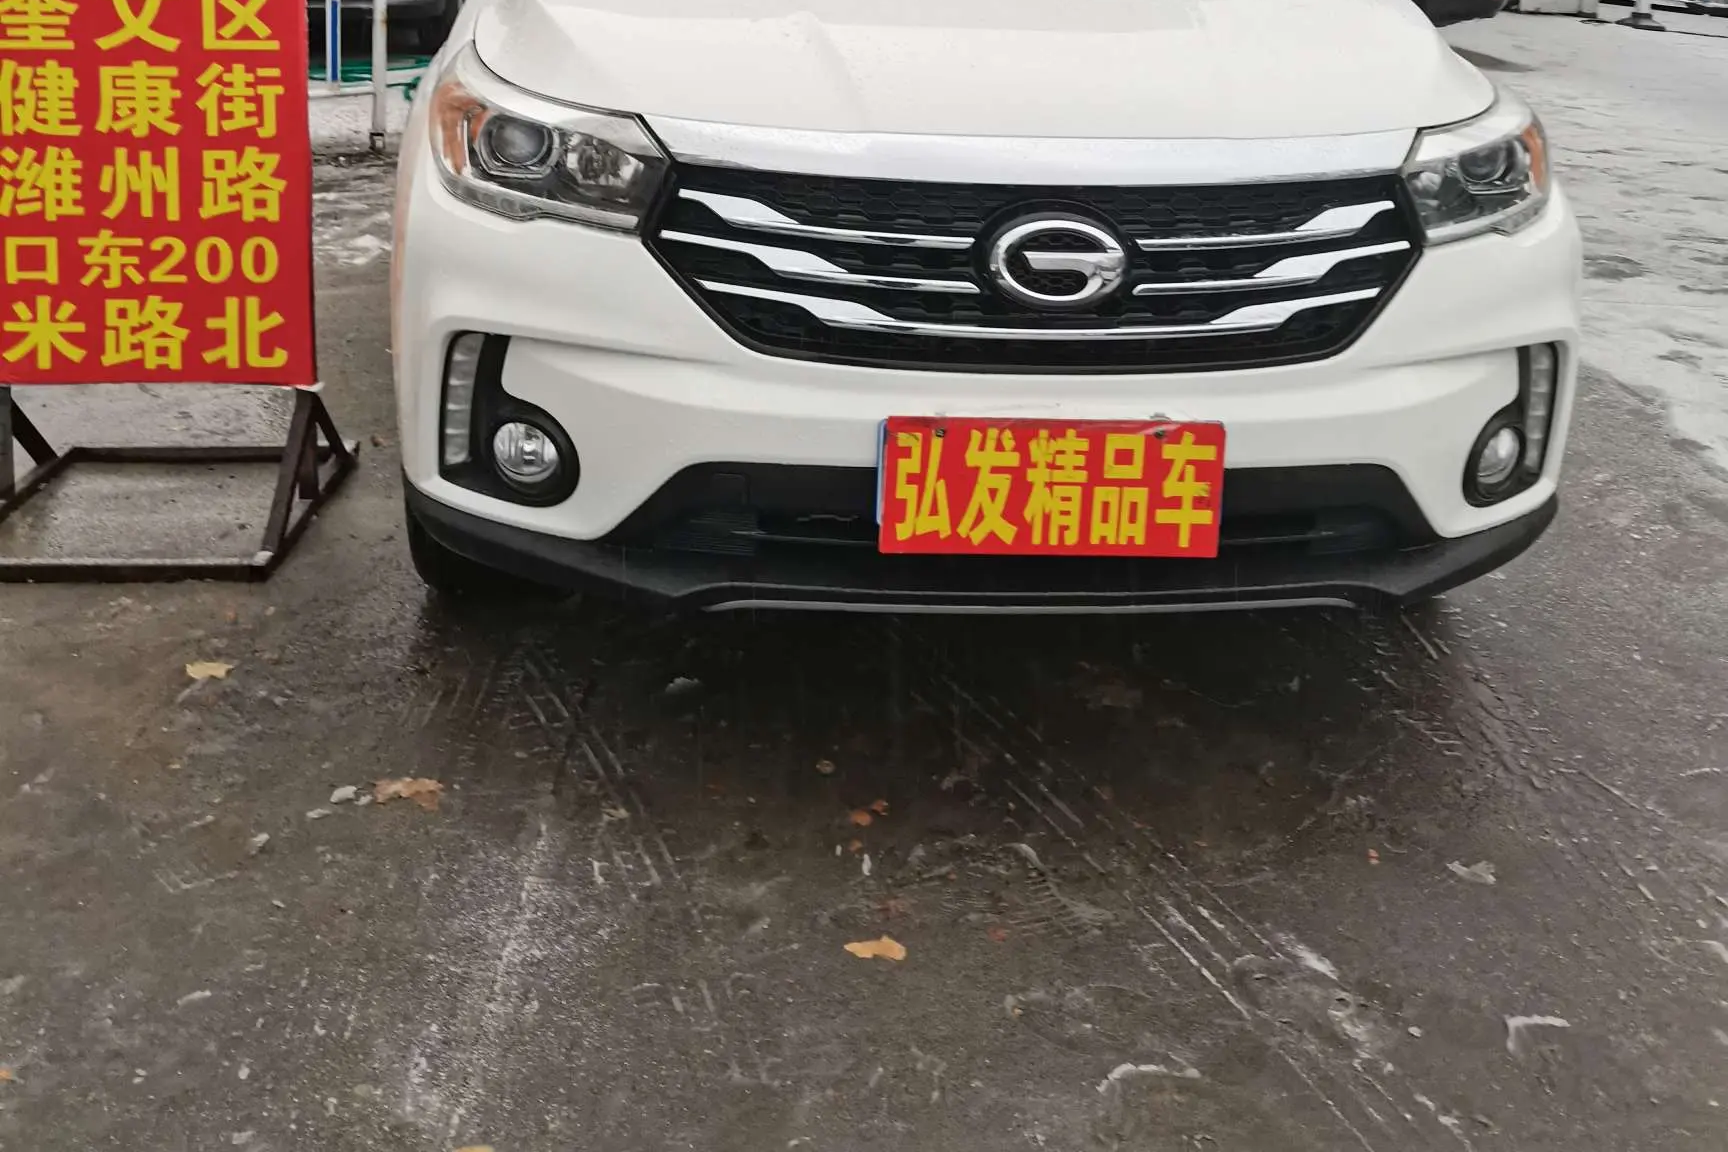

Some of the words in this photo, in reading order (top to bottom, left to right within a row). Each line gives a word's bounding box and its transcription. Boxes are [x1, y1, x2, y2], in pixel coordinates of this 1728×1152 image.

[0, 59, 284, 138] 健康街
[0, 146, 287, 222] 潍州路
[4, 230, 280, 289] 口东200
[2, 295, 289, 370] 米路北
[895, 428, 1217, 548] 弘发精品车
